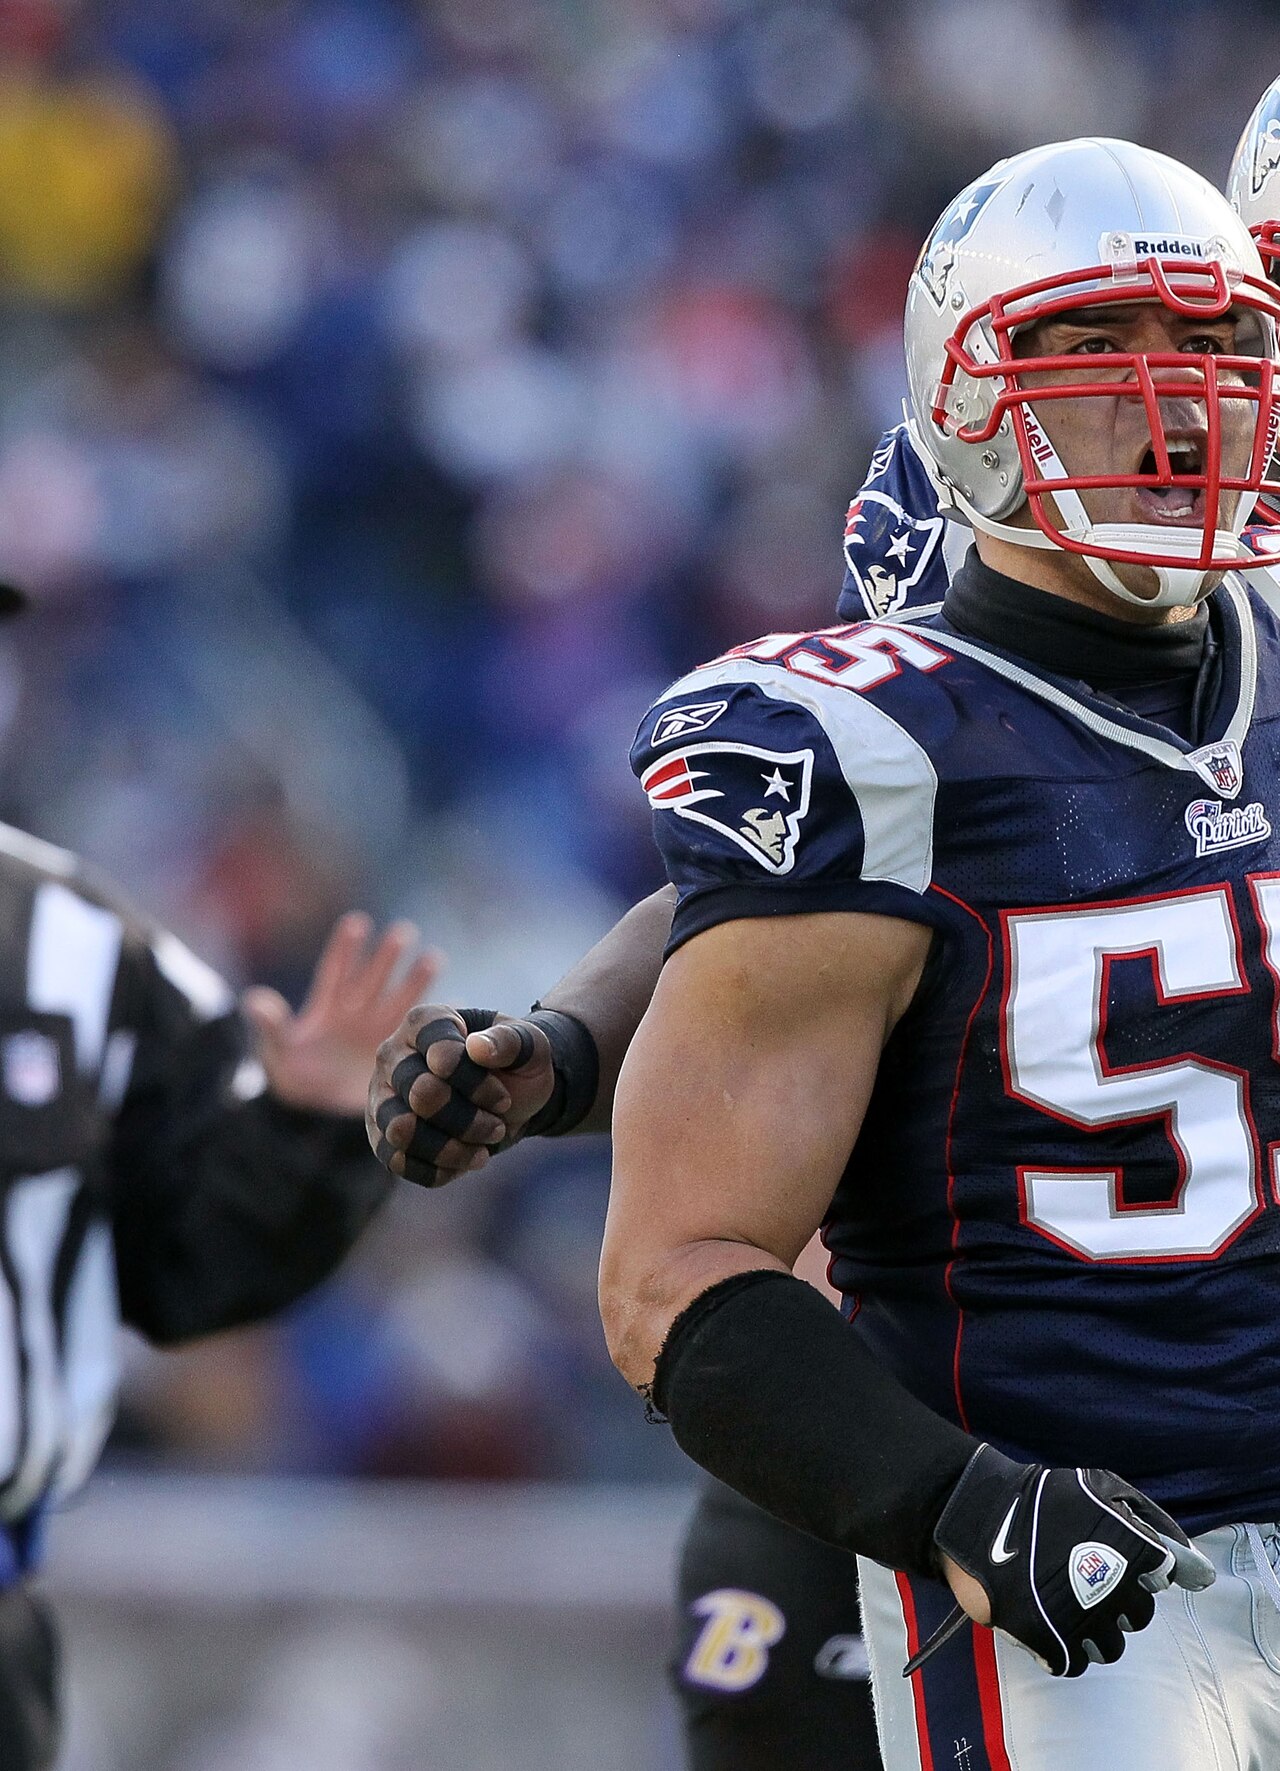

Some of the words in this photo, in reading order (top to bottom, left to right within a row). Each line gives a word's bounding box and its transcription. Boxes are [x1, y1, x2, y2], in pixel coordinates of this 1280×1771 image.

[1134, 240, 1203, 258] Riddell
[1191, 803, 1270, 853] Patriots
[1079, 1553, 1104, 1576] NFL
